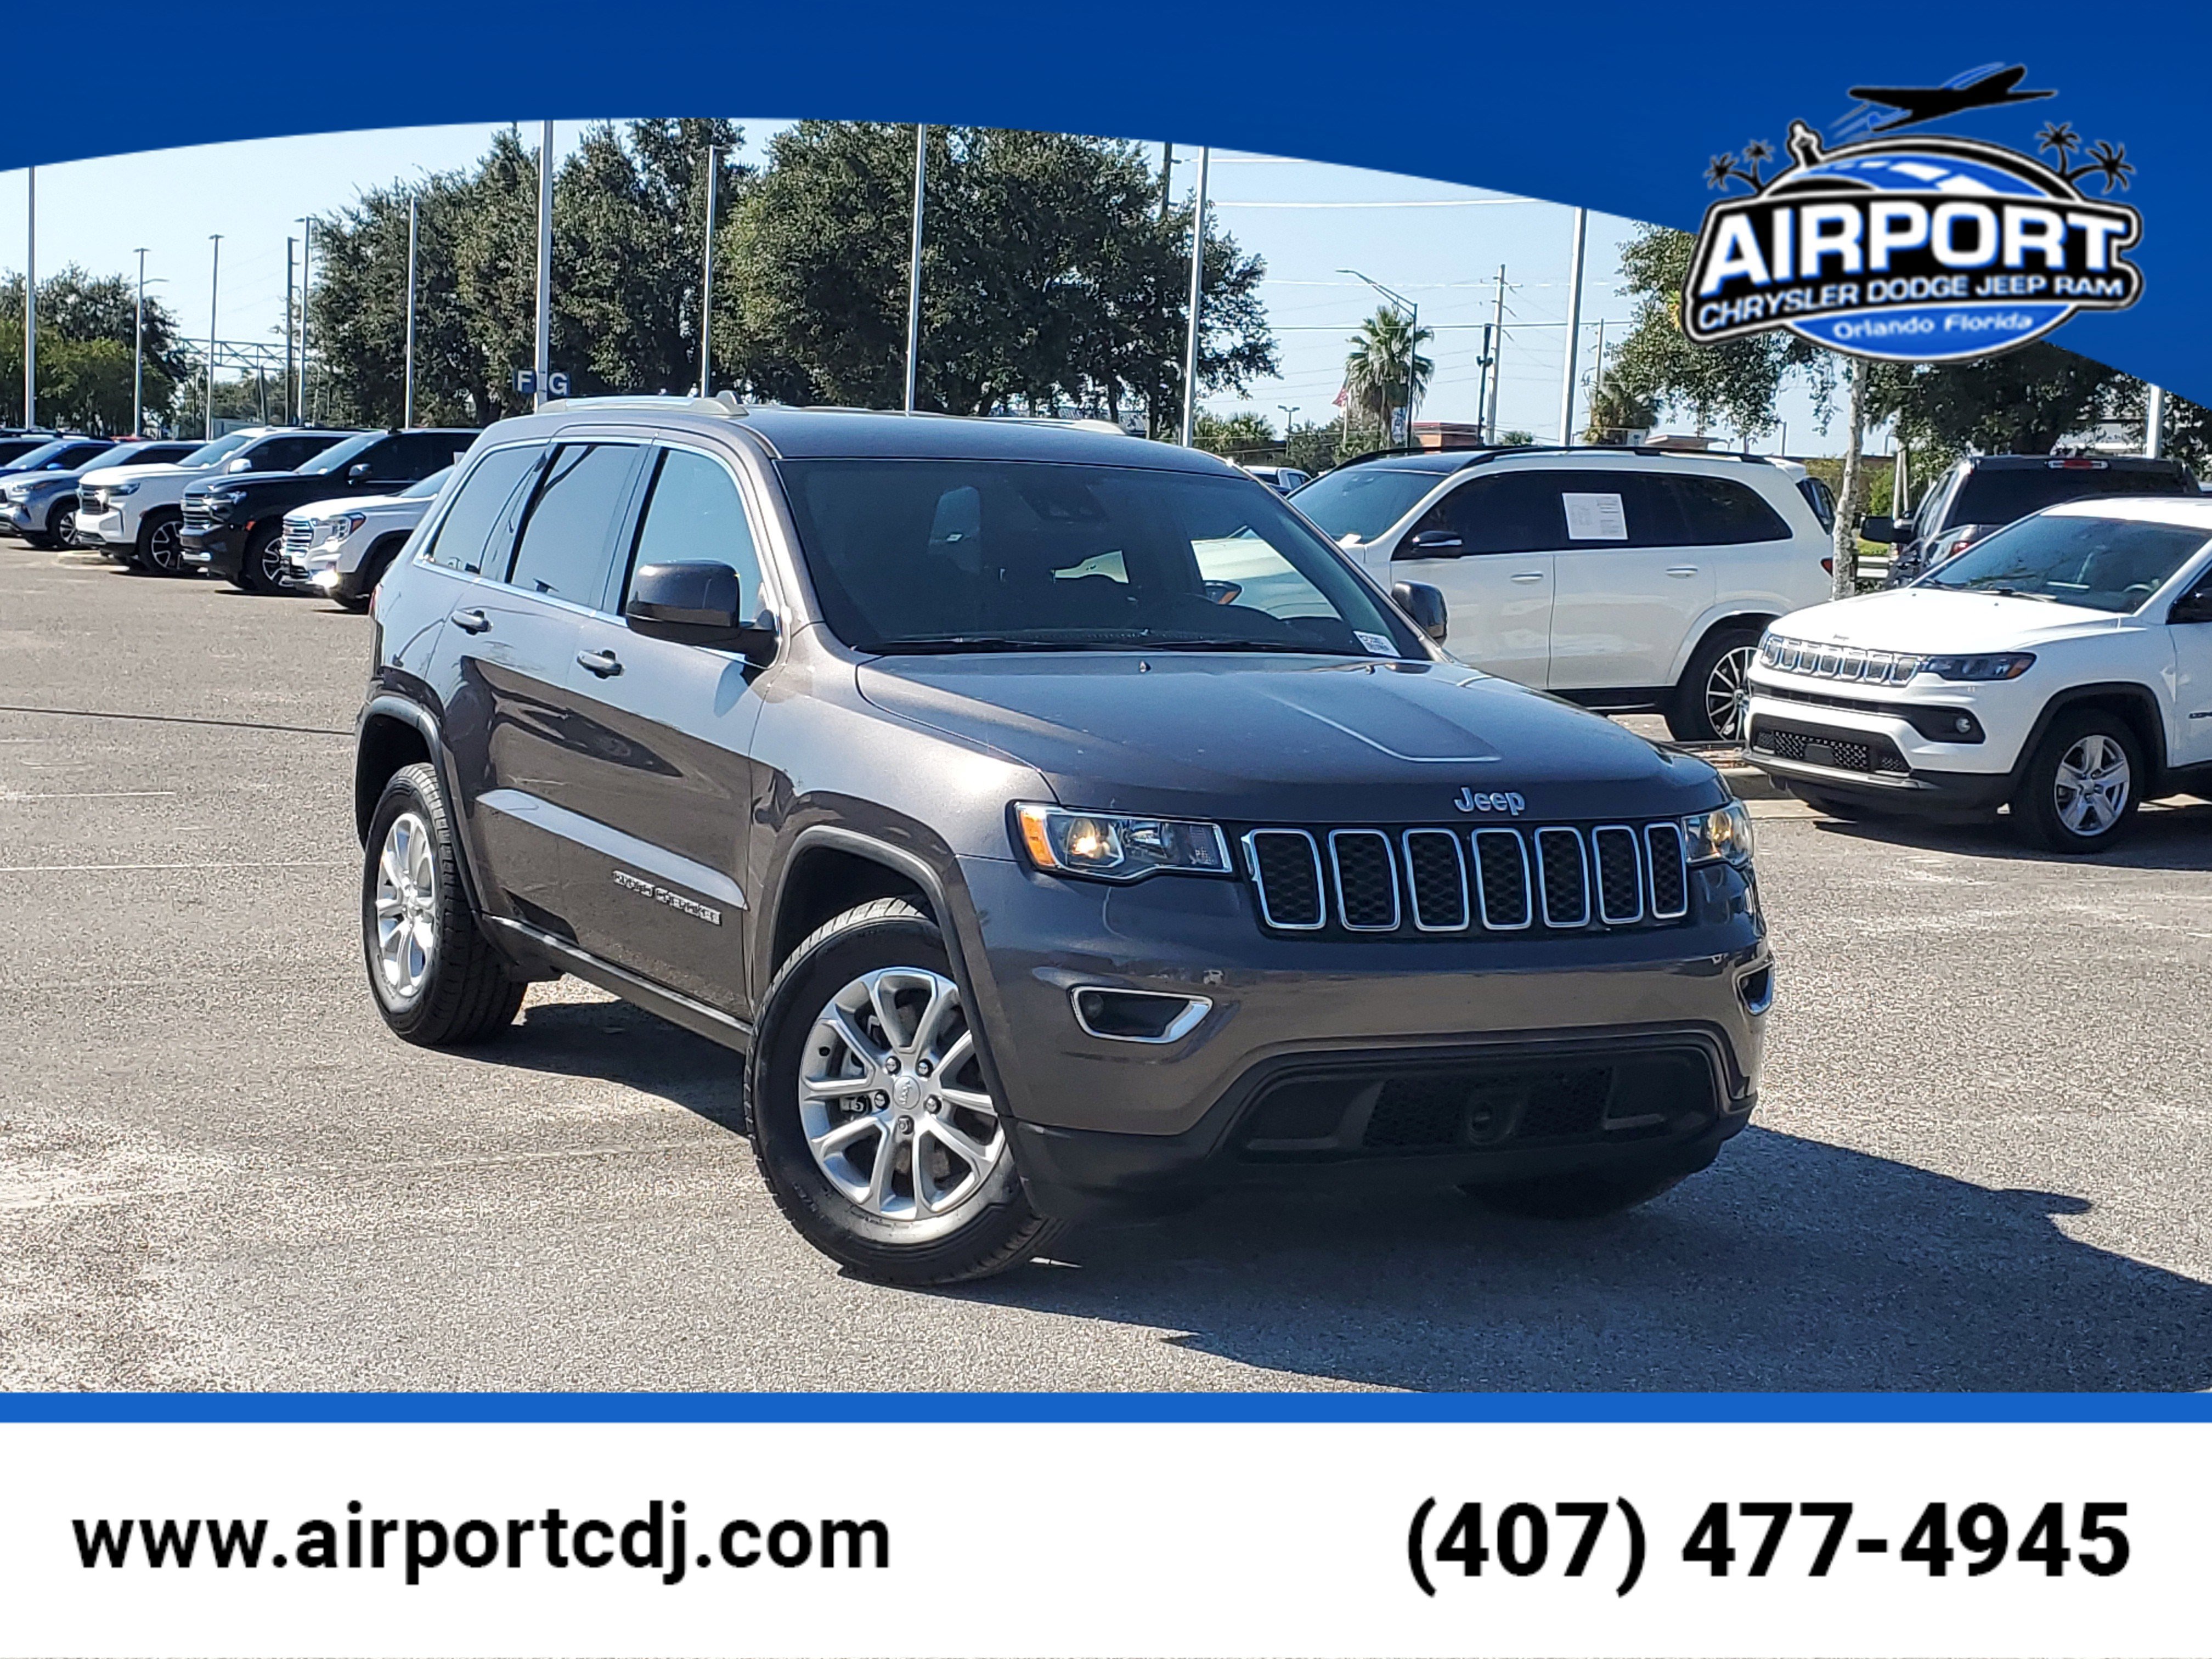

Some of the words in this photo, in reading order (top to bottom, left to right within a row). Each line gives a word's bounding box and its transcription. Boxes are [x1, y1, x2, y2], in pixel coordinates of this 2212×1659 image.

[517, 370, 533, 392] F
[549, 372, 568, 395] G
[1454, 787, 1526, 816] Jeep
